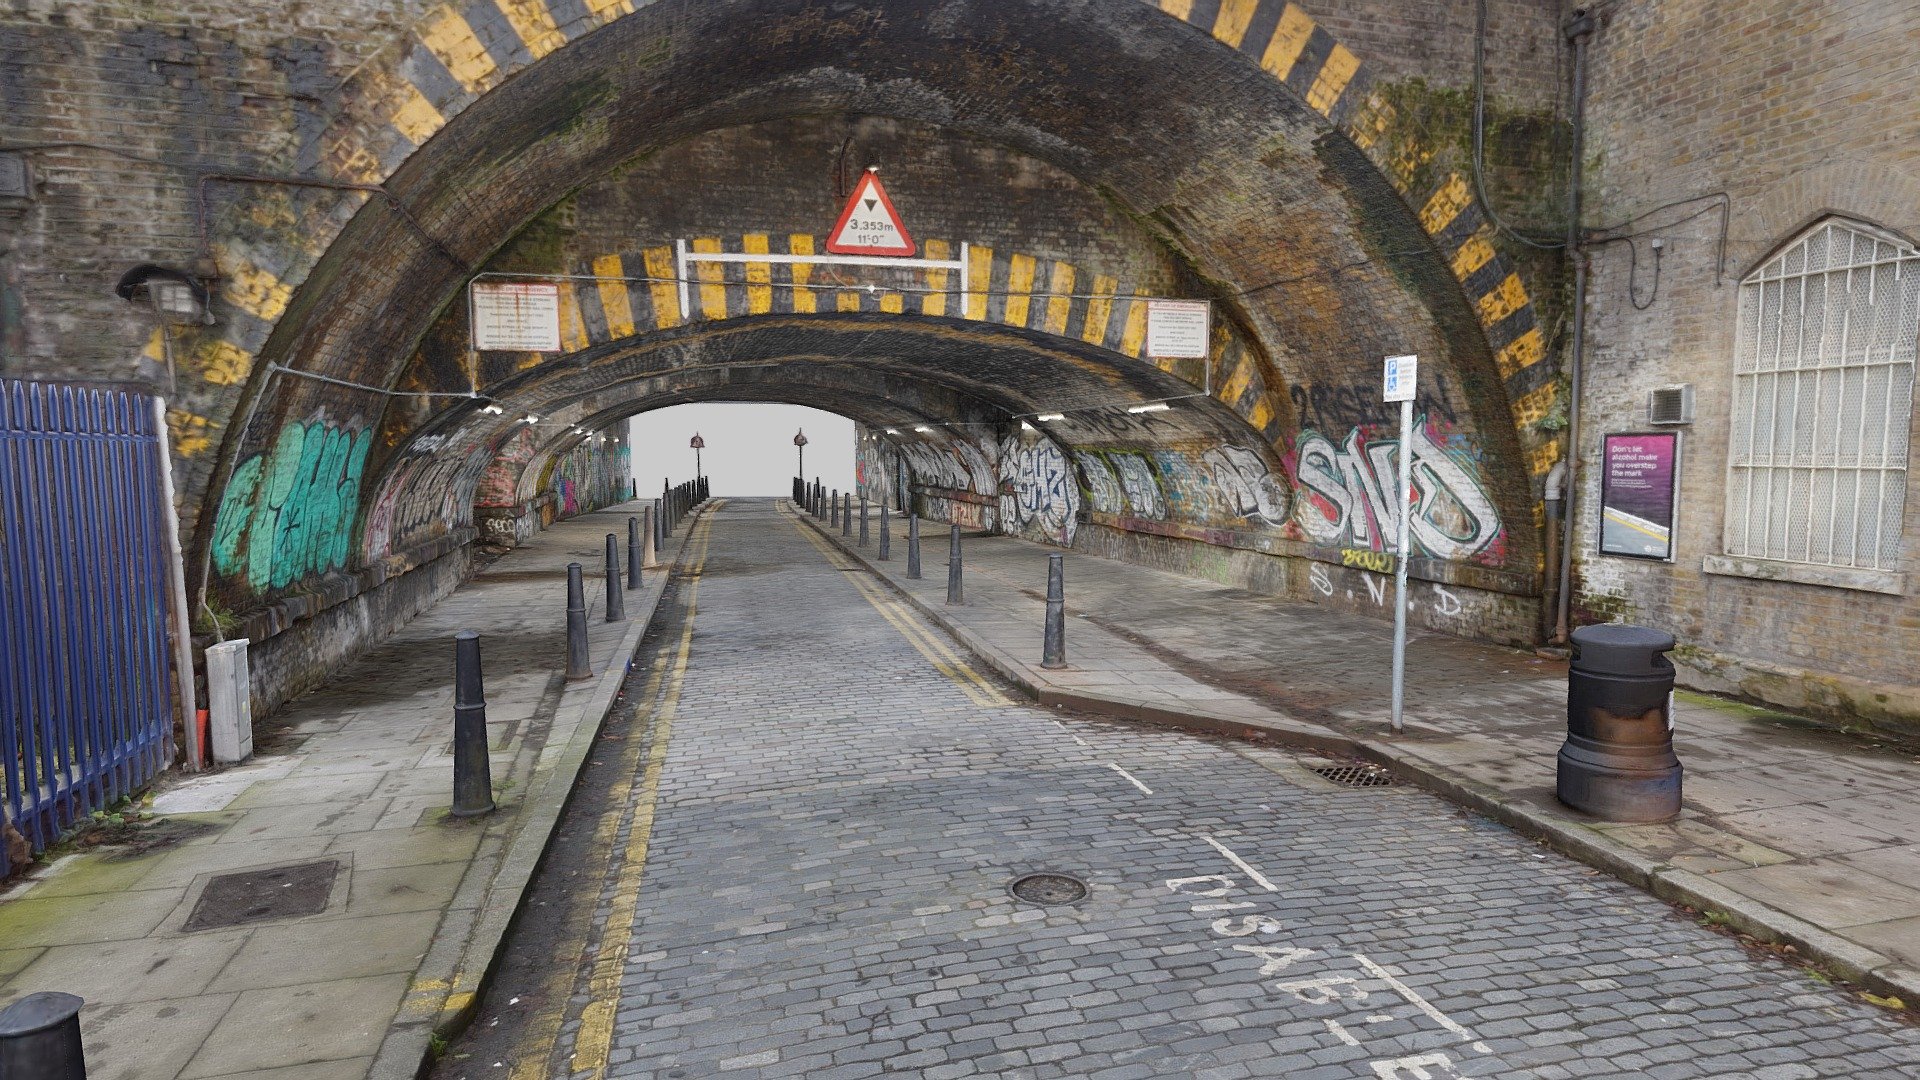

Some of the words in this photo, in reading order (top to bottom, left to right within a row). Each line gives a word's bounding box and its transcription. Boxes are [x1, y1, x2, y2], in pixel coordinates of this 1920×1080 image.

[850, 219, 893, 231] 3.353m
[1612, 445, 1631, 453] Don't
[1632, 445, 1642, 453] let
[1612, 453, 1637, 461] alcohol
[1625, 462, 1657, 470] overstep
